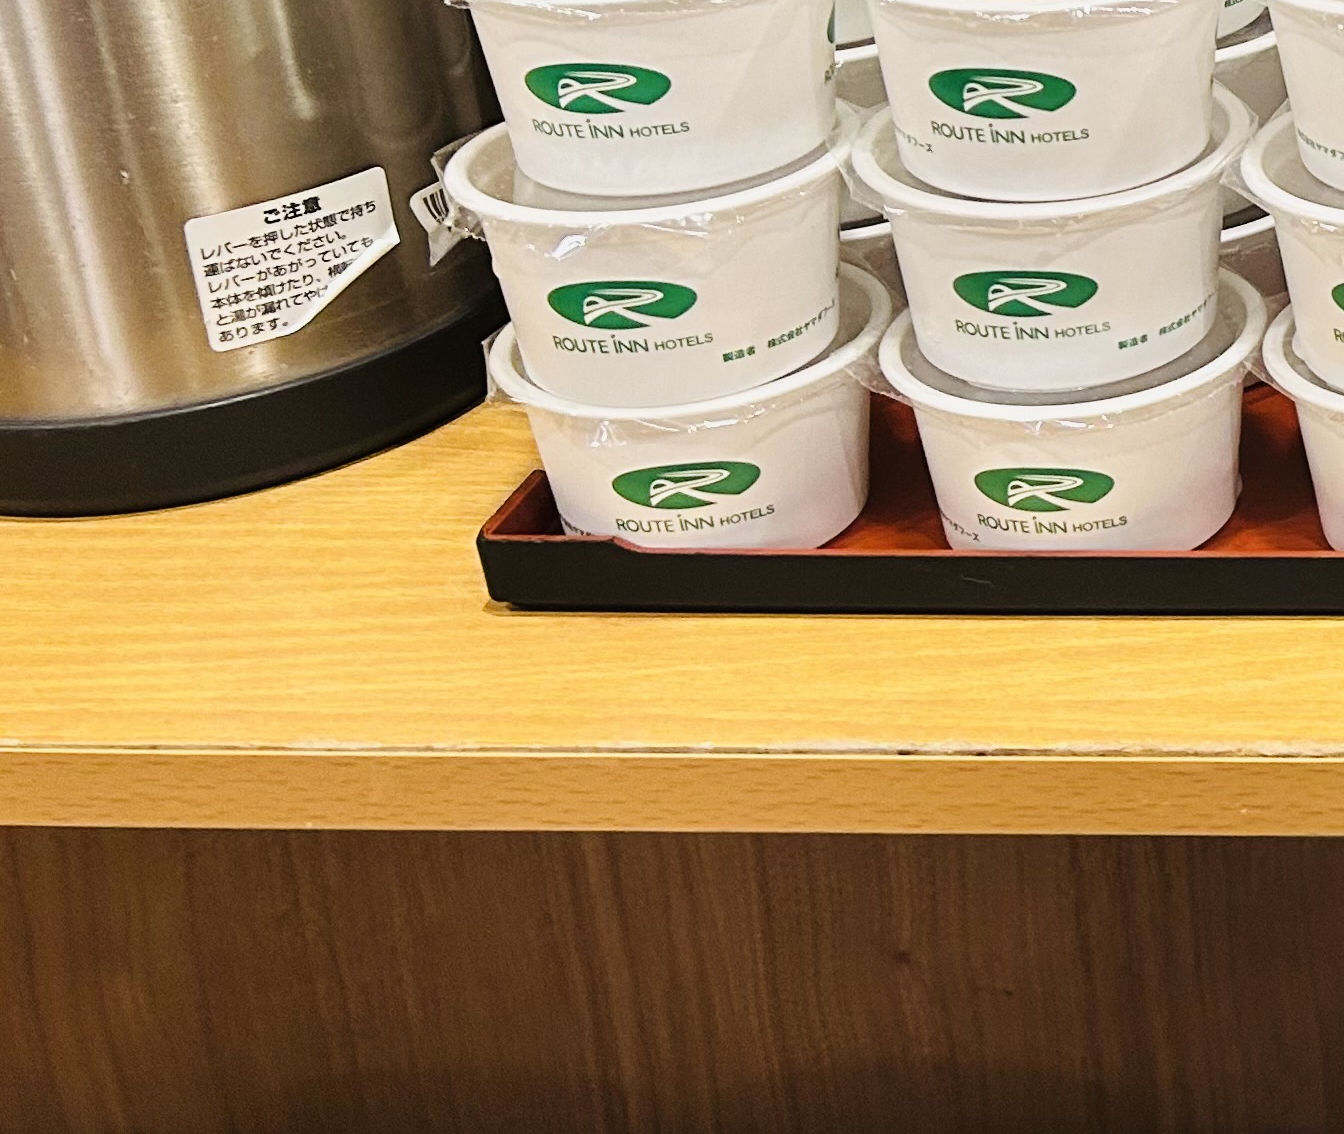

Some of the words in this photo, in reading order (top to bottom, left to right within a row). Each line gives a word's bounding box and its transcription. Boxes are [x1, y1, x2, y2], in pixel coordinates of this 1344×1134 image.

[532, 118, 586, 139] ROUTE
[630, 121, 691, 139] HOTELS
[931, 120, 986, 143] ROUTE
[1031, 129, 1090, 143] HOTELS
[263, 195, 322, 225] ご注意
[207, 235, 374, 294] レバーがあがっていても
[218, 317, 290, 343] あります。
[954, 319, 1011, 340] ROUTE
[1054, 322, 1111, 339] HOTELS
[553, 335, 610, 354] ROUTE
[654, 332, 714, 351] HOTELS
[615, 518, 674, 534] ROUTE
[719, 504, 776, 527] HOTELS
[976, 514, 1031, 534] ROUTE
[1072, 516, 1128, 533] HOTELS
